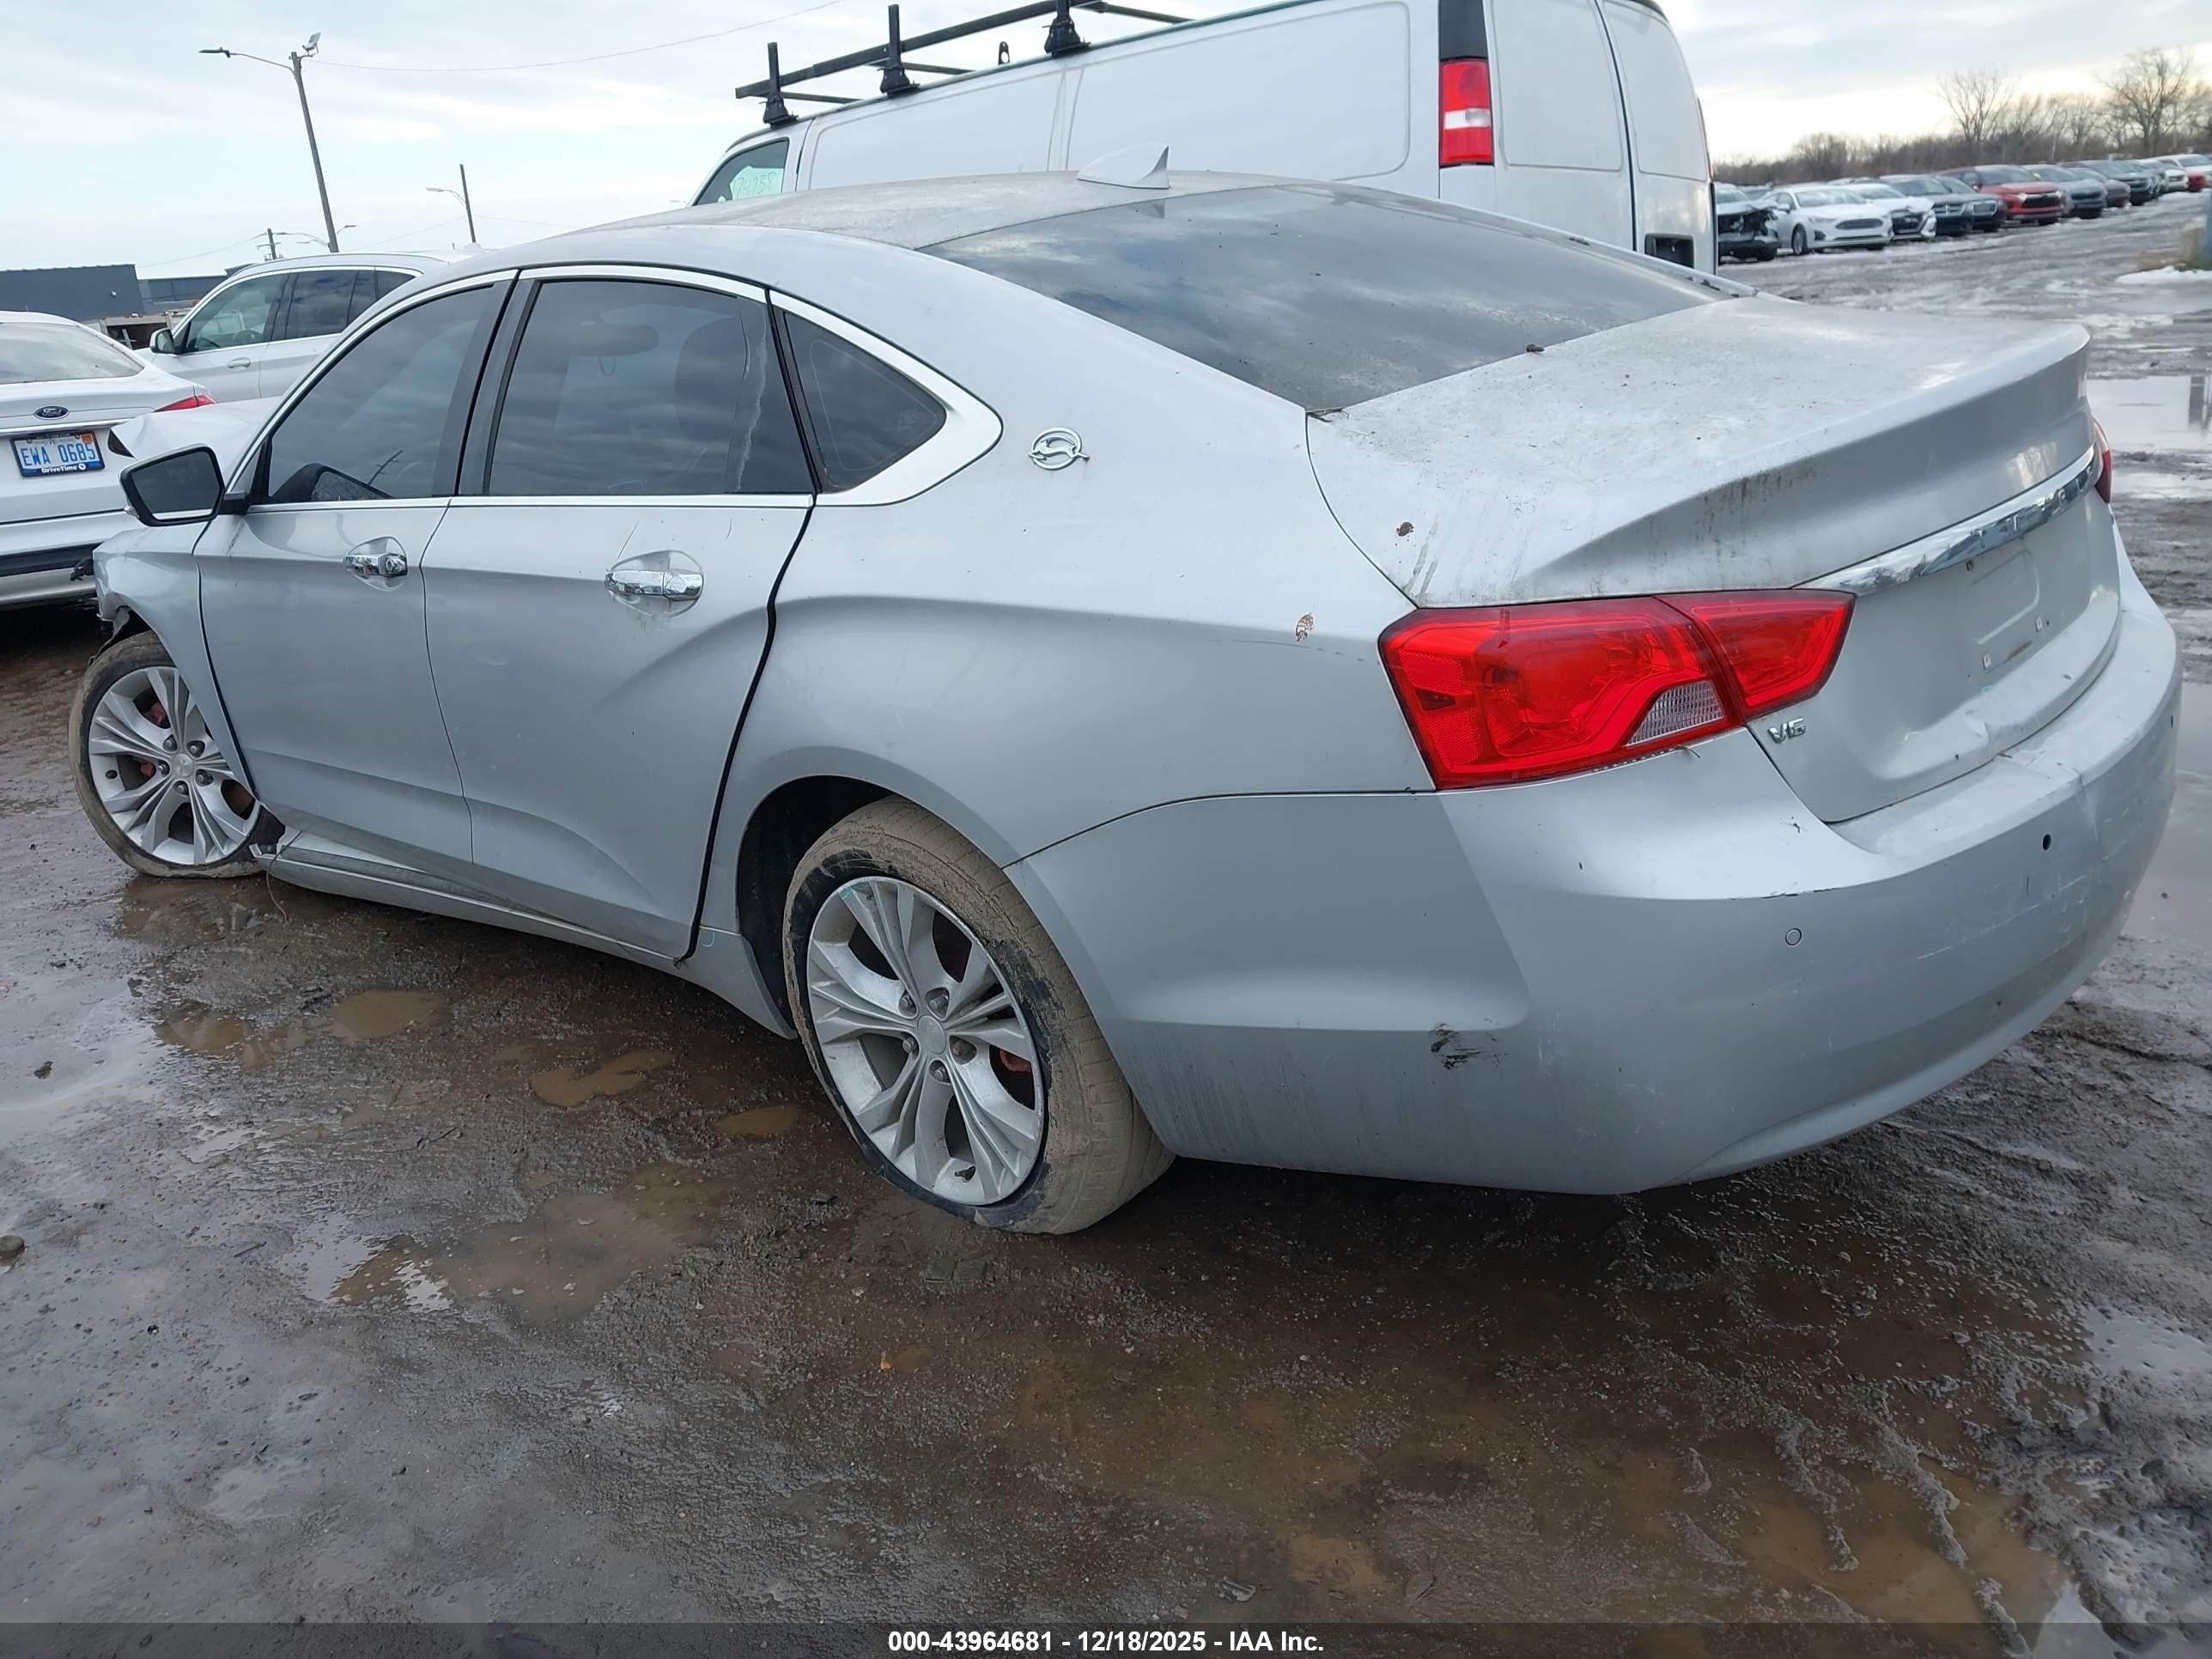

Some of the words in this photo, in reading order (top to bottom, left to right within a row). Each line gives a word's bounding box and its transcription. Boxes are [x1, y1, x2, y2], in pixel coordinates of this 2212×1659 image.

[20, 447, 51, 466] EWA
[58, 443, 96, 463] 0685
[41, 465, 77, 473] DriveTime
[1767, 716, 1806, 744] V6
